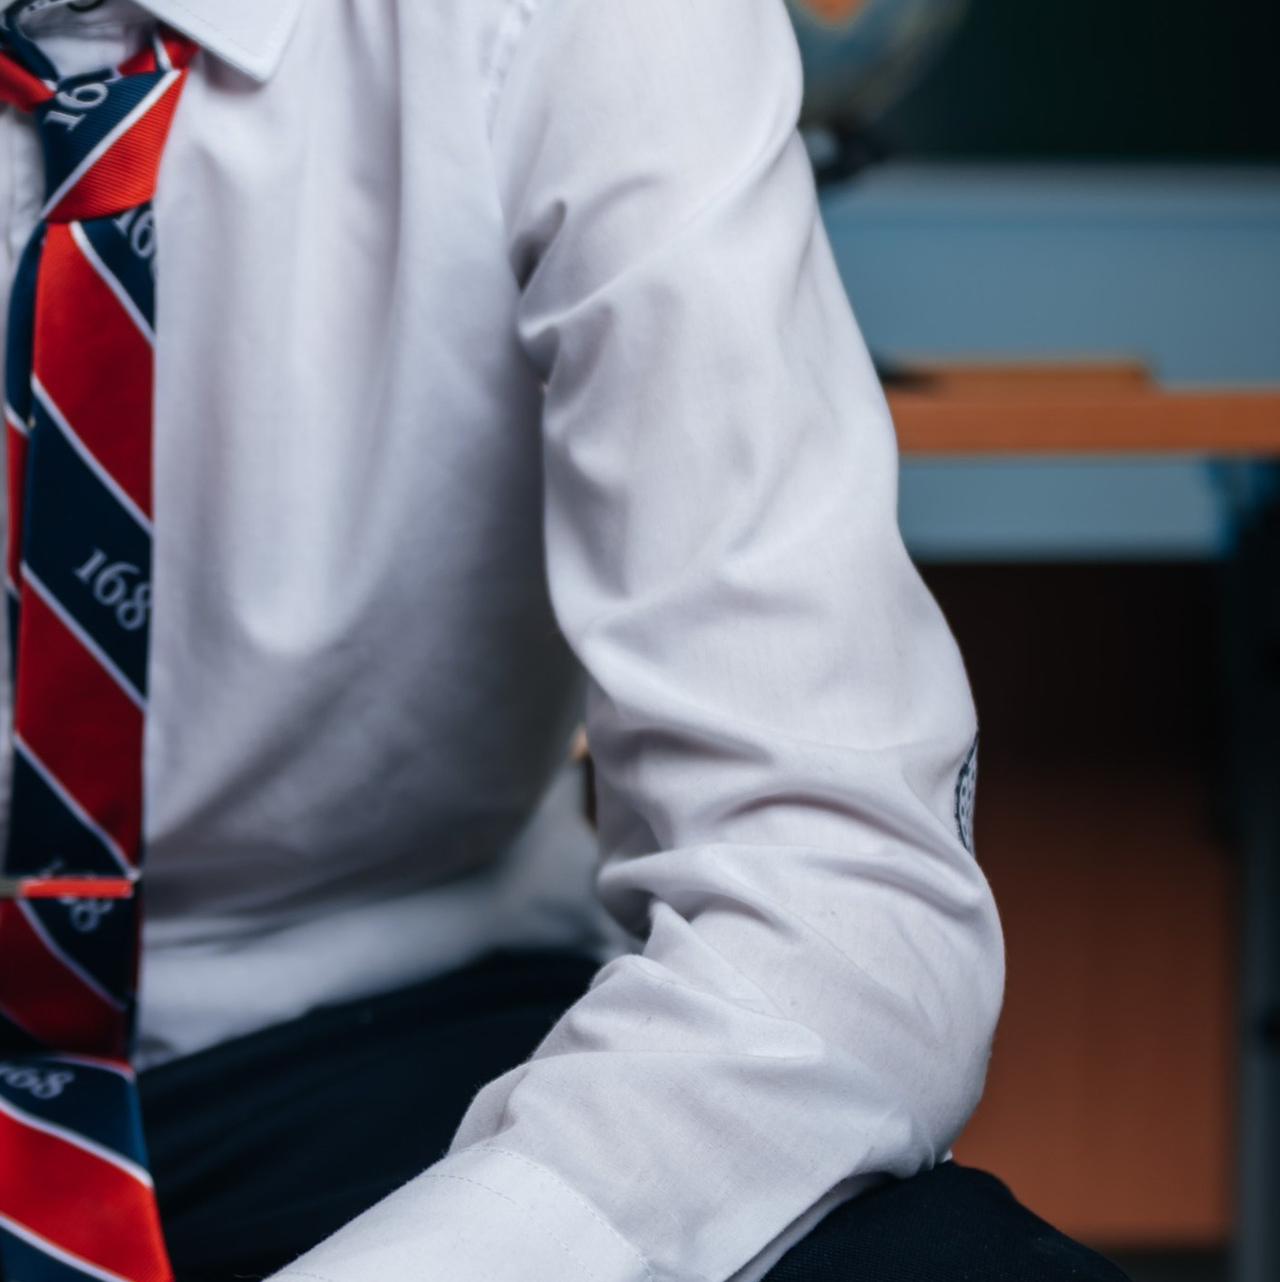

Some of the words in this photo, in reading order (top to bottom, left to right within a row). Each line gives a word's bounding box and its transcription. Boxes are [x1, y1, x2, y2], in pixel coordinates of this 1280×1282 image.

[42, 81, 109, 132] 16
[112, 207, 157, 277] 16
[73, 546, 151, 630] 168
